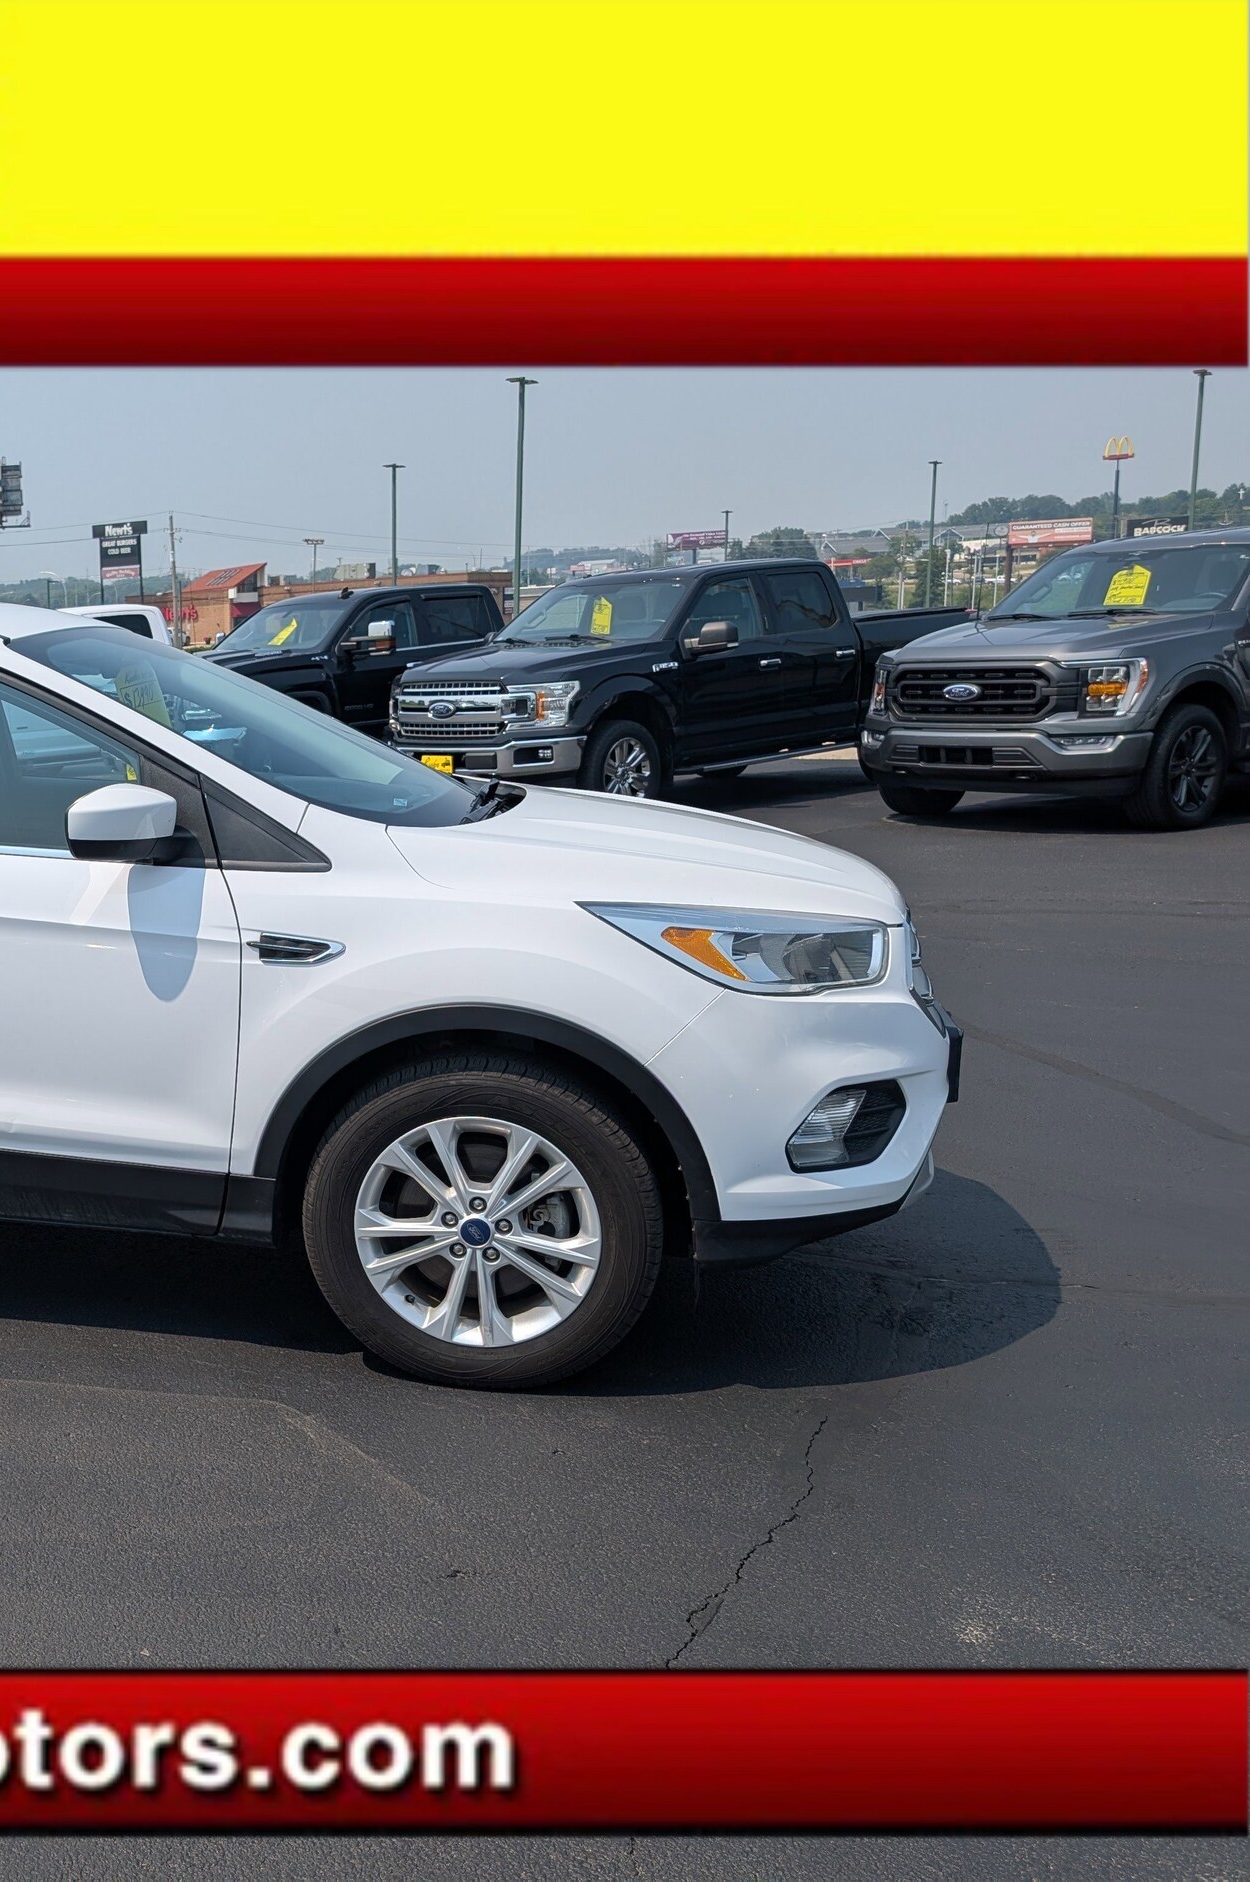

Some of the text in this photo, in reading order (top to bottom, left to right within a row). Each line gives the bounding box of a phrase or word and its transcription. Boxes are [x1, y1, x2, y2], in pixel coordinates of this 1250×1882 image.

[104, 522, 133, 537] Newt's
[1012, 523, 1053, 531] GUARANTEED
[101, 538, 138, 548] GREAT BURGERS
